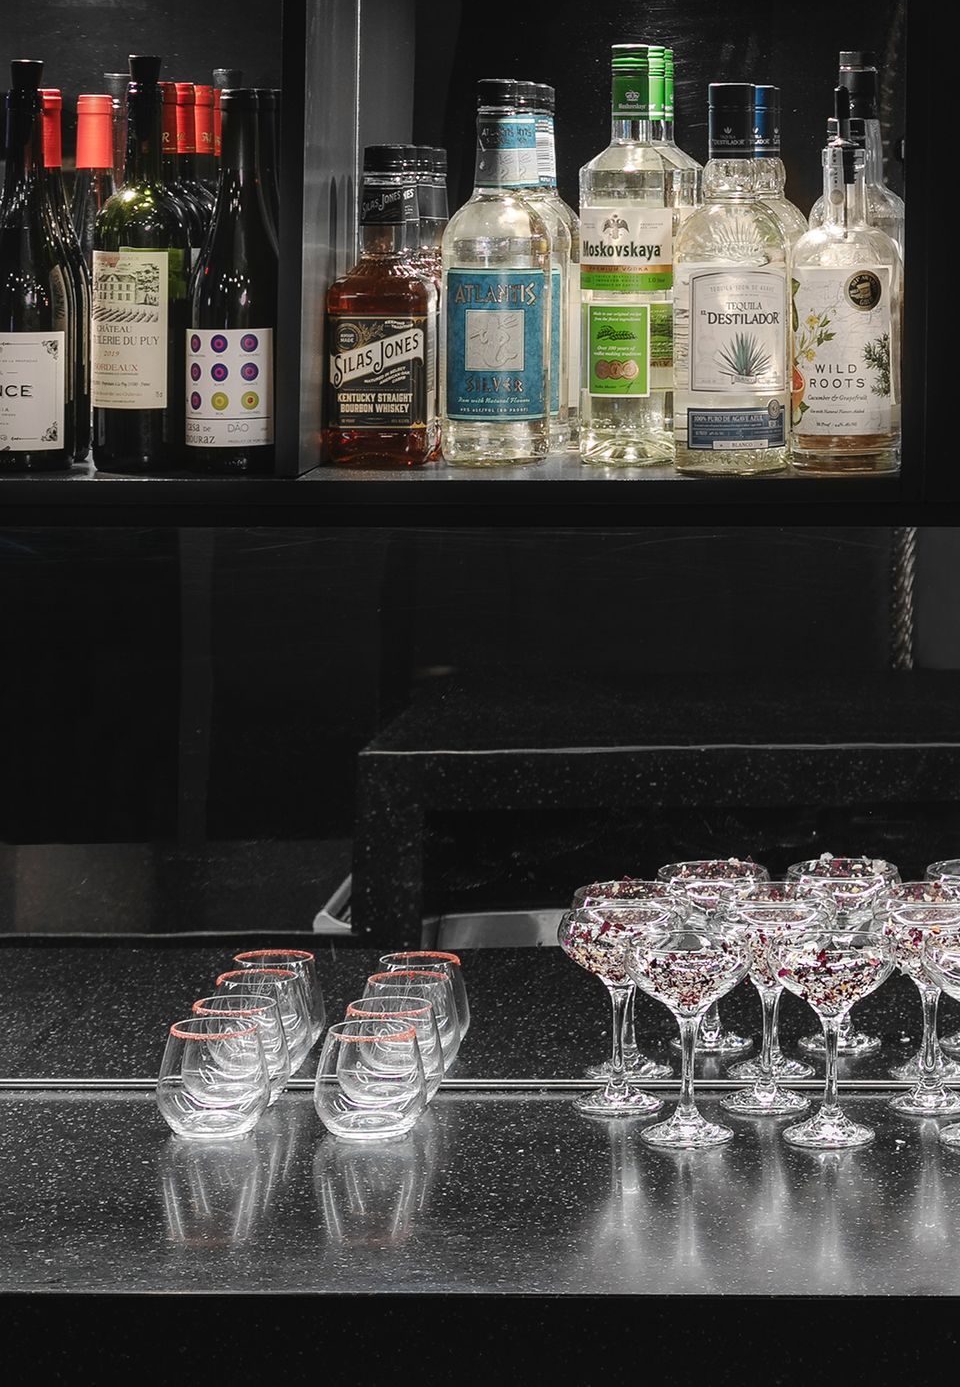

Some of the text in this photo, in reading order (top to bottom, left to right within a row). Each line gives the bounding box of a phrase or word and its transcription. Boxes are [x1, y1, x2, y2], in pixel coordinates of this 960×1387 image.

[582, 240, 661, 261] Moskovskaya
[455, 283, 537, 306] ATLANTIS
[725, 302, 763, 312] TEQUILA
[707, 311, 779, 325] DESTILADOR
[123, 336, 160, 346] DU PUY
[333, 333, 419, 389] SILAS JONES
[815, 363, 858, 374] WILD
[465, 376, 523, 392] SILVER
[810, 378, 865, 389] ROOTS
[337, 393, 413, 403] KENTUCKY STRAIGHT
[340, 403, 410, 412] BOURBON WHISKEY
